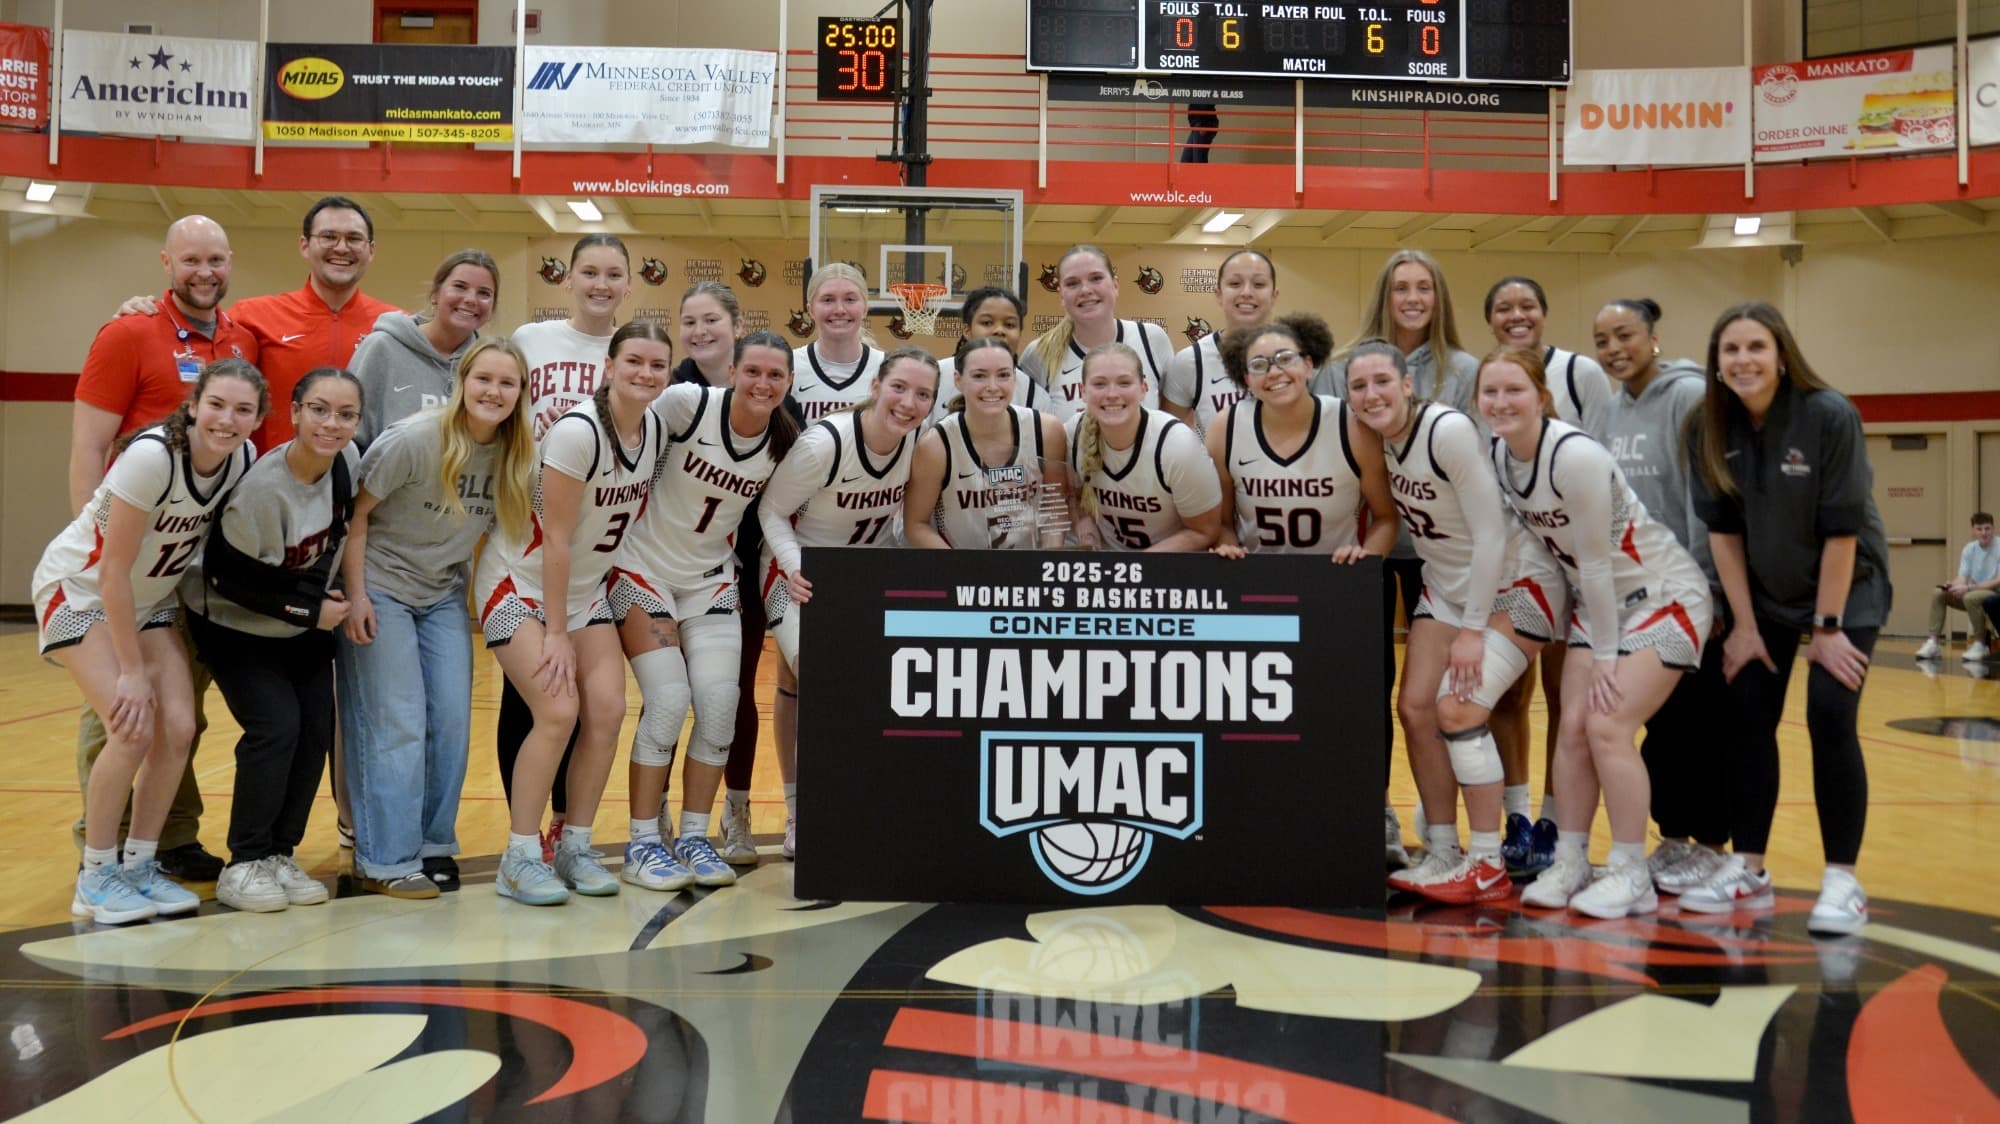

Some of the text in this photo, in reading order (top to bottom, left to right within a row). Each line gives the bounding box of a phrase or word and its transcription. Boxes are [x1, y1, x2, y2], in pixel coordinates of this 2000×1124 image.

[1160, 2, 1200, 15] FOULS
[1214, 3, 1249, 16] T.O.L.
[1262, 5, 1346, 20] PLAYER FOUL
[1358, 8, 1392, 21] T.O.L.
[1407, 10, 1446, 23] FOULS
[825, 24, 896, 48] 25:00
[1175, 18, 1194, 47] 0
[1222, 19, 1240, 49] 6
[1366, 24, 1384, 54] 6
[1421, 25, 1440, 55] 0
[0, 58, 38, 75] RRIE
[838, 50, 885, 90] 30
[1159, 55, 1200, 68] SCORE
[1283, 58, 1326, 72] MATCH
[1408, 62, 1448, 75] SCORE
[1807, 58, 1890, 78] MANKATO
[352, 74, 391, 85] TRUST
[393, 75, 416, 85] THE
[418, 76, 455, 86] MIDAS
[585, 62, 697, 81] MINNESOTA
[704, 63, 773, 85] VALLEY
[70, 74, 249, 109] AmericInn
[609, 81, 753, 95] FEDERAL CREDIT UNION
[1172, 88, 1191, 97] AUTO
[1193, 89, 1212, 98] BODY
[1212, 90, 1219, 98] &
[1221, 90, 1244, 99] GLASS
[1351, 88, 1500, 107] KINSHIPRADIO.ORG
[115, 110, 203, 122] BY WYNDHAM
[385, 107, 501, 120] midasmankato.com
[1580, 101, 1734, 131] DUNKIN'
[276, 126, 501, 138] 1050 Madison Avenue 507-345-8205
[1757, 124, 1849, 141] ORDER ONLINE
[573, 178, 730, 197] www.blcvikings.com
[1129, 189, 1213, 205] www.blc.edu
[1183, 269, 1216, 277] BETHANY
[529, 361, 597, 407] BETH
[681, 449, 768, 499] VIKINGS
[990, 467, 1023, 483] UMAC
[1241, 476, 1335, 498] VIKINGS
[1093, 487, 1162, 513] KINGS
[693, 495, 724, 535] 1
[592, 511, 631, 554] 3
[1254, 506, 1323, 548] 50
[145, 535, 202, 577] 12
[1041, 562, 1143, 584] 2025-26
[956, 585, 1229, 610] WOMEN'S BASKETBALL
[989, 615, 1196, 637] CONFERENCE
[890, 646, 1294, 722] CHAMPIONS
[994, 745, 1189, 825] UMAC
